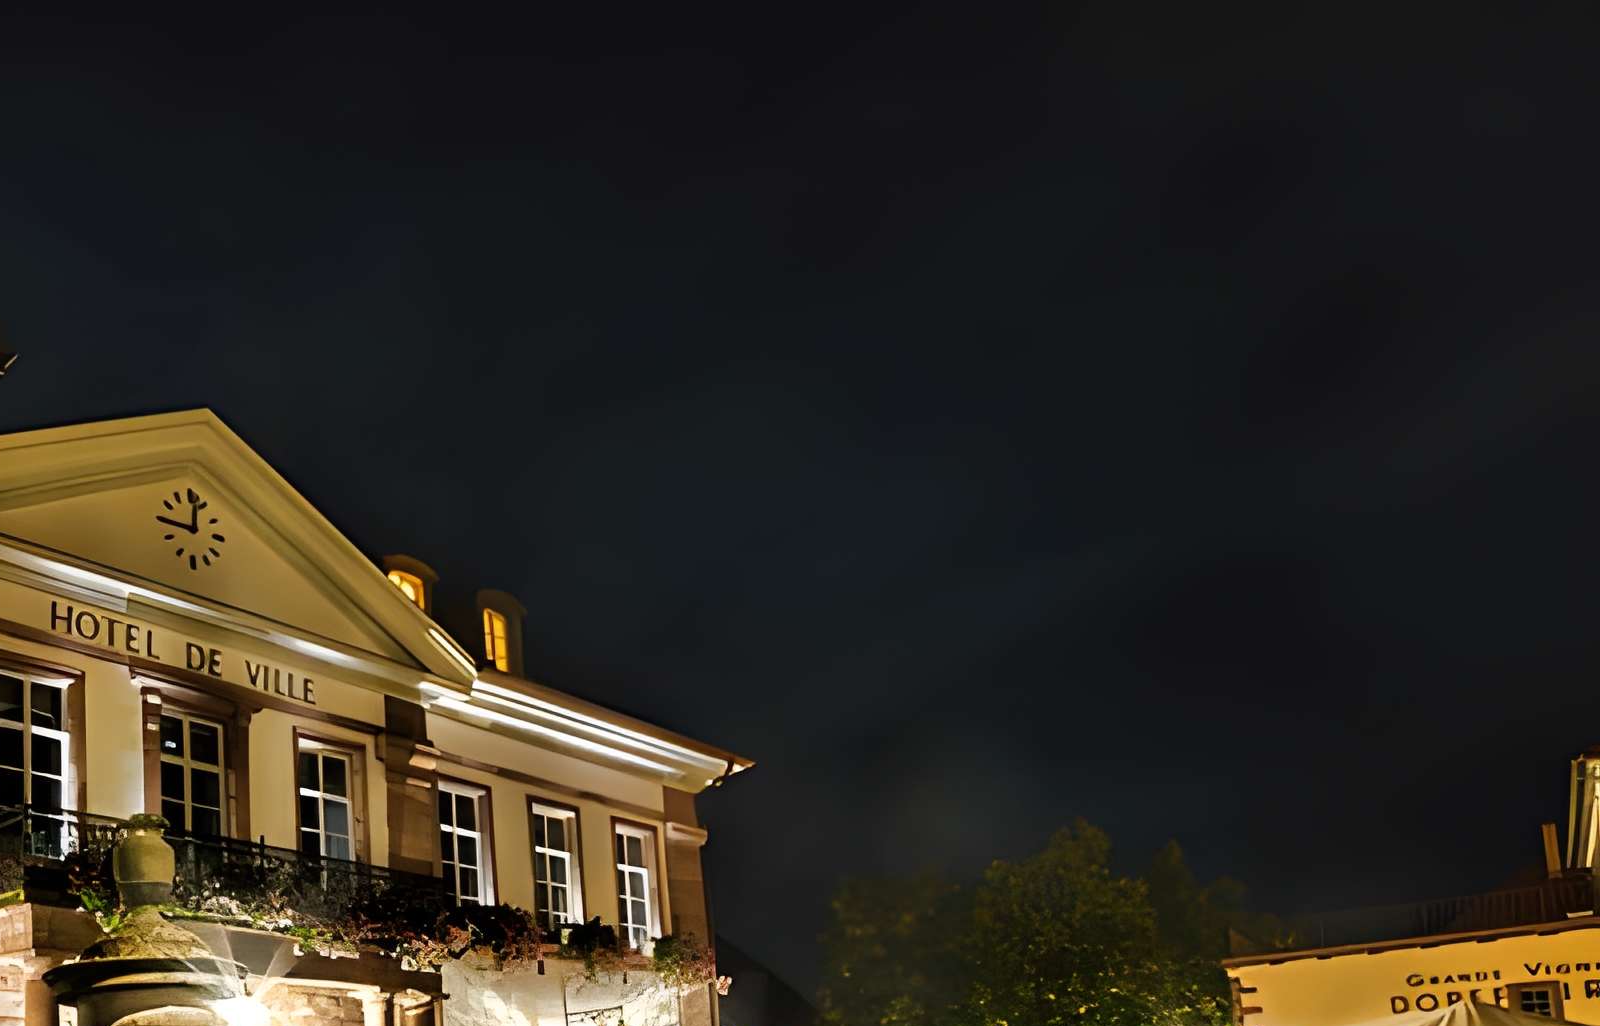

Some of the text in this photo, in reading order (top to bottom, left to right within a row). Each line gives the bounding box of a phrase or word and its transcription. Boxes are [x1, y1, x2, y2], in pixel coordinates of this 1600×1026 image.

[50, 600, 317, 705] HOTEL DE VILLE
